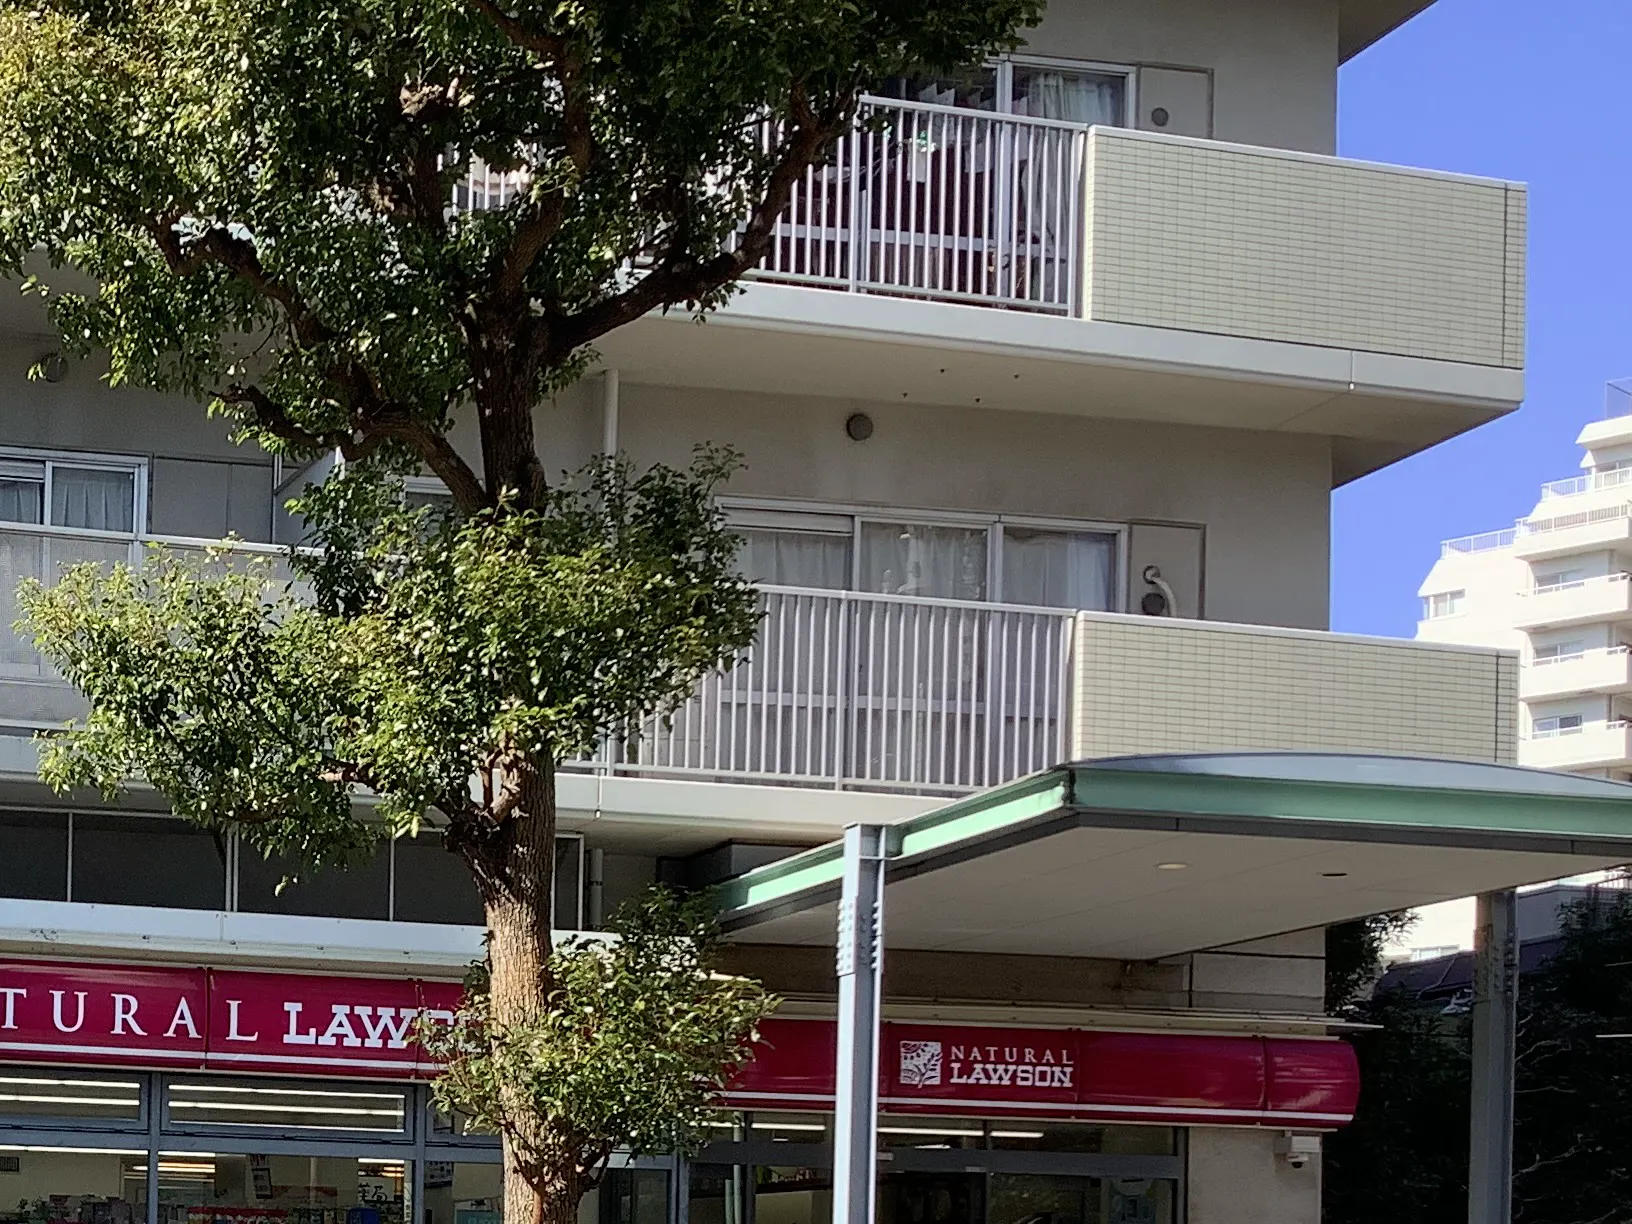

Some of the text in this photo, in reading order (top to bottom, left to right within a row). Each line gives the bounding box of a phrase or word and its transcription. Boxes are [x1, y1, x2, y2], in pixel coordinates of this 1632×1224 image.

[282, 1001, 486, 1053] LAW
[950, 1045, 1075, 1065] NATURAL
[949, 1062, 1074, 1088] LAWSON
